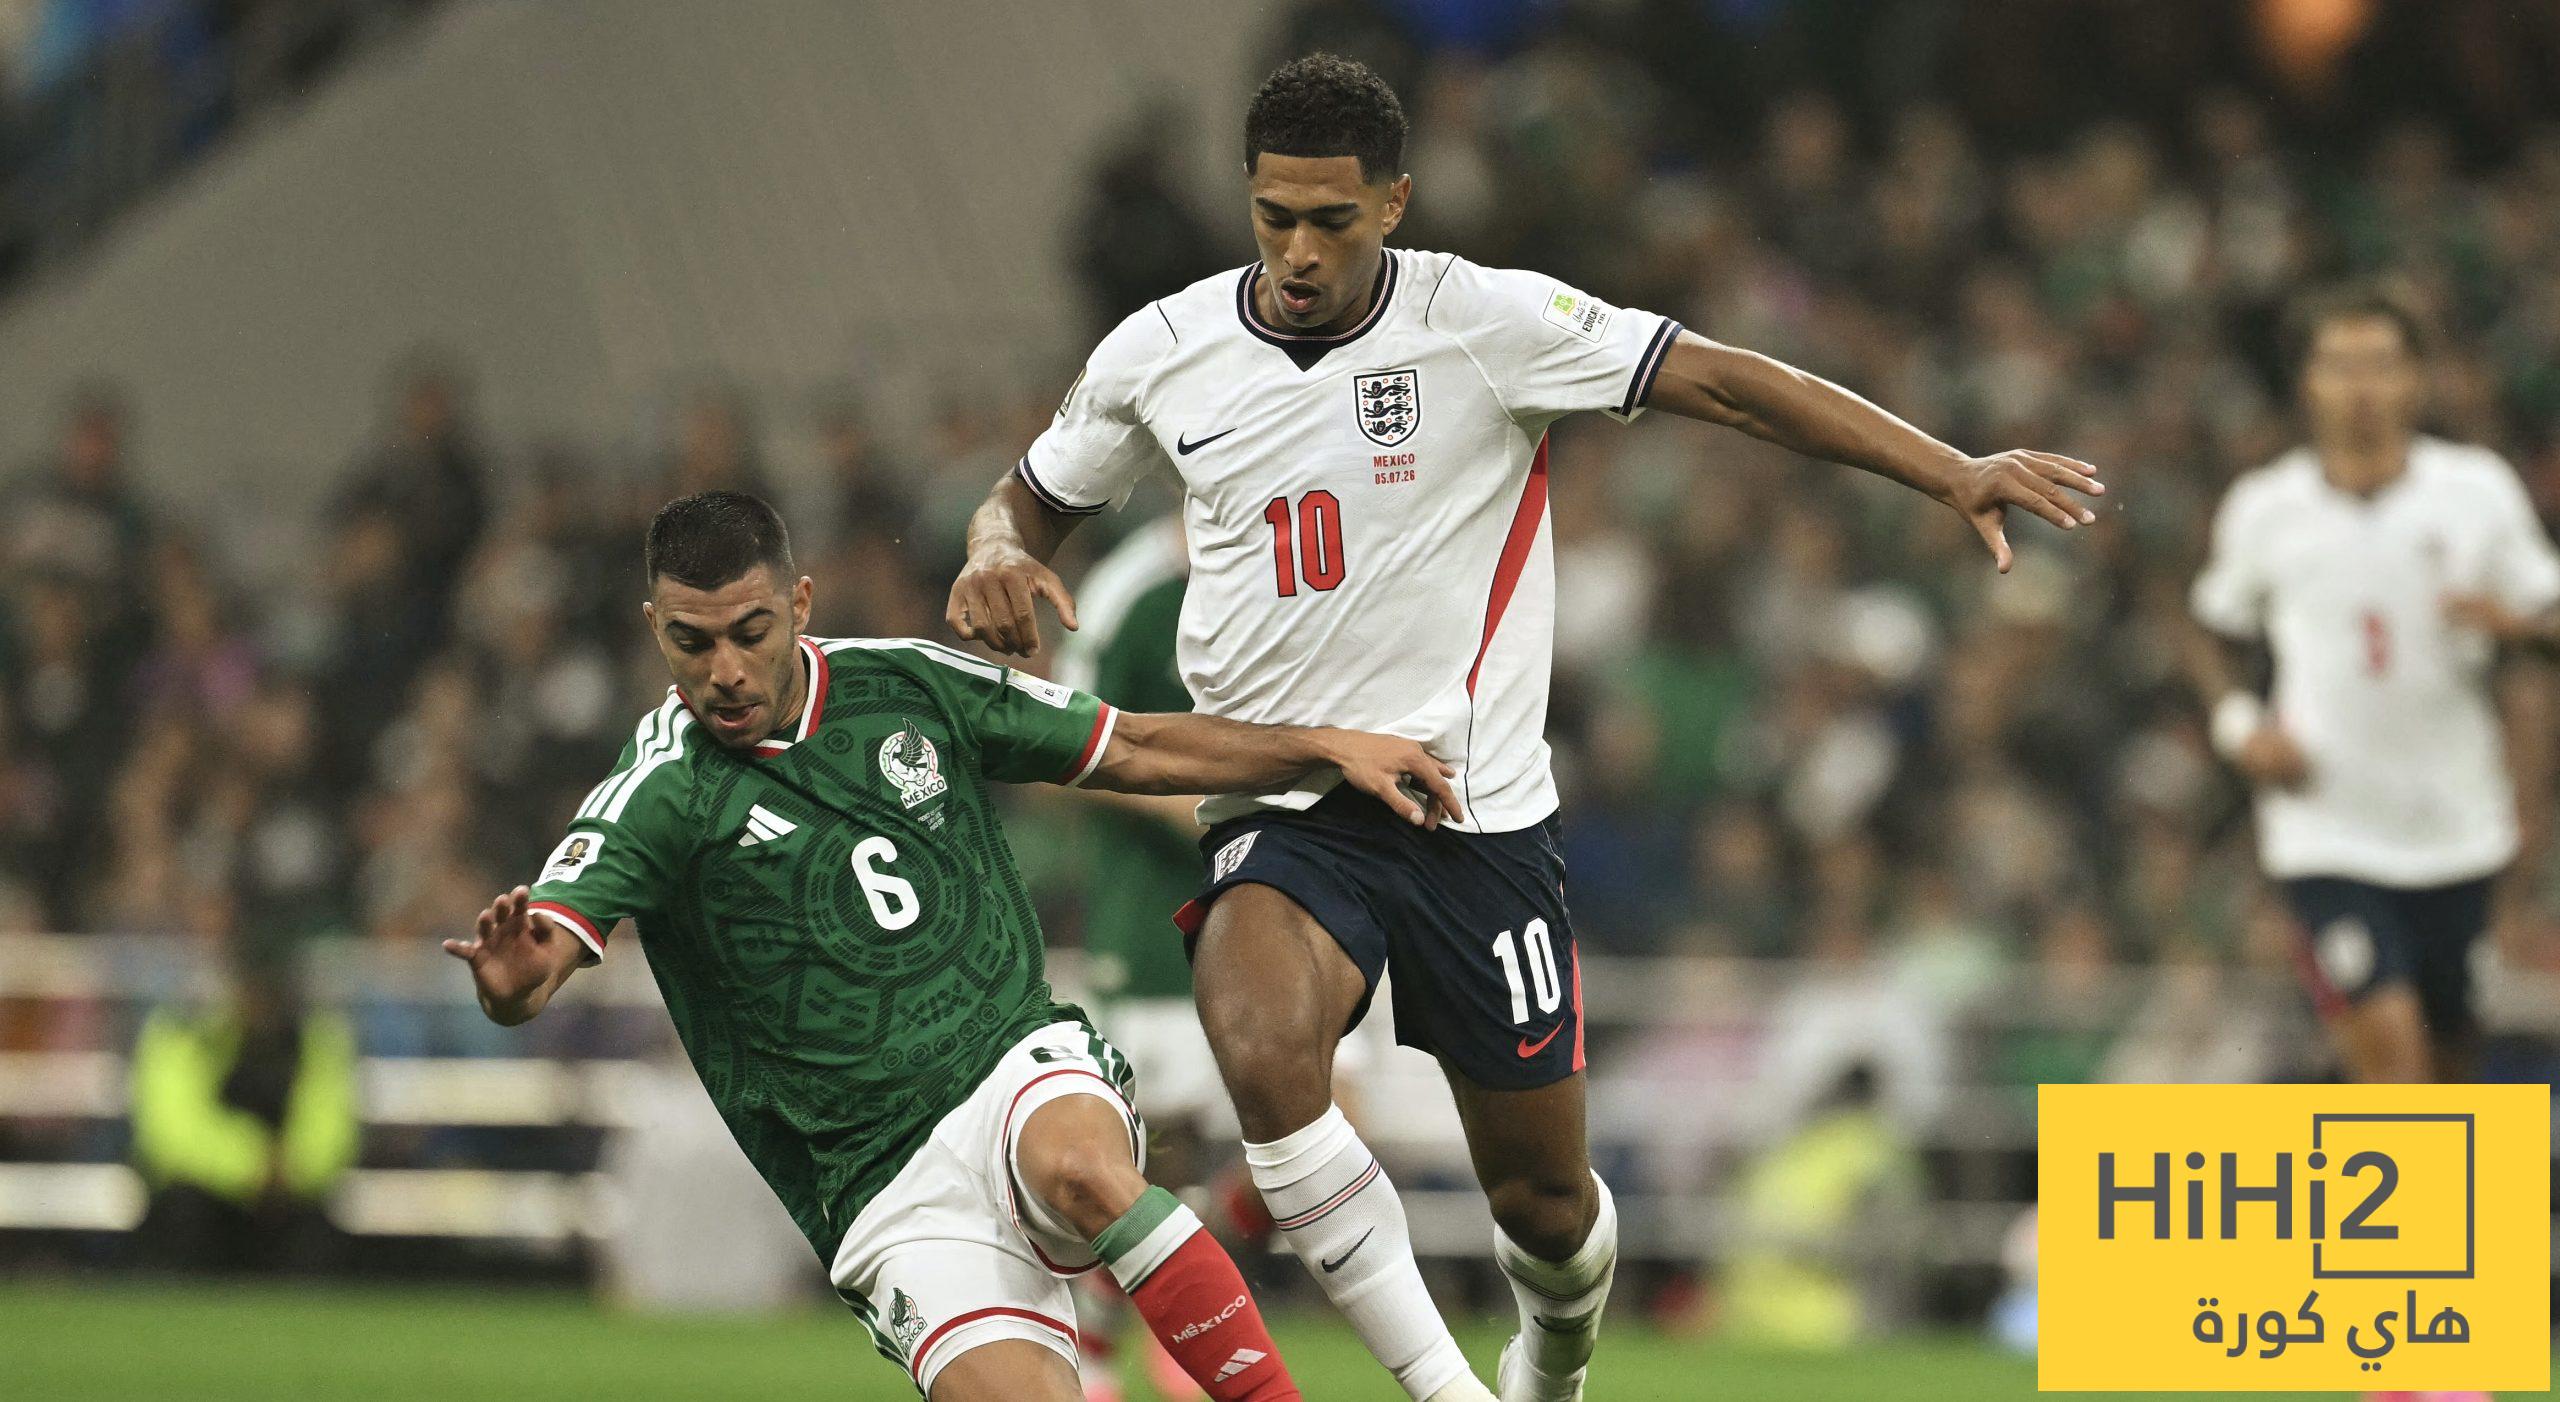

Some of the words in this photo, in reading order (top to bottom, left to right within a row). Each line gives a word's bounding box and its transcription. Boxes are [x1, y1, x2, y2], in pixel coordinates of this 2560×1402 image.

[1373, 453, 1415, 467] MEXICO
[1374, 470, 1415, 484] 05.07.26
[1264, 490, 1346, 597] 10
[851, 836, 920, 931] 6
[1492, 917, 1562, 1025] 10
